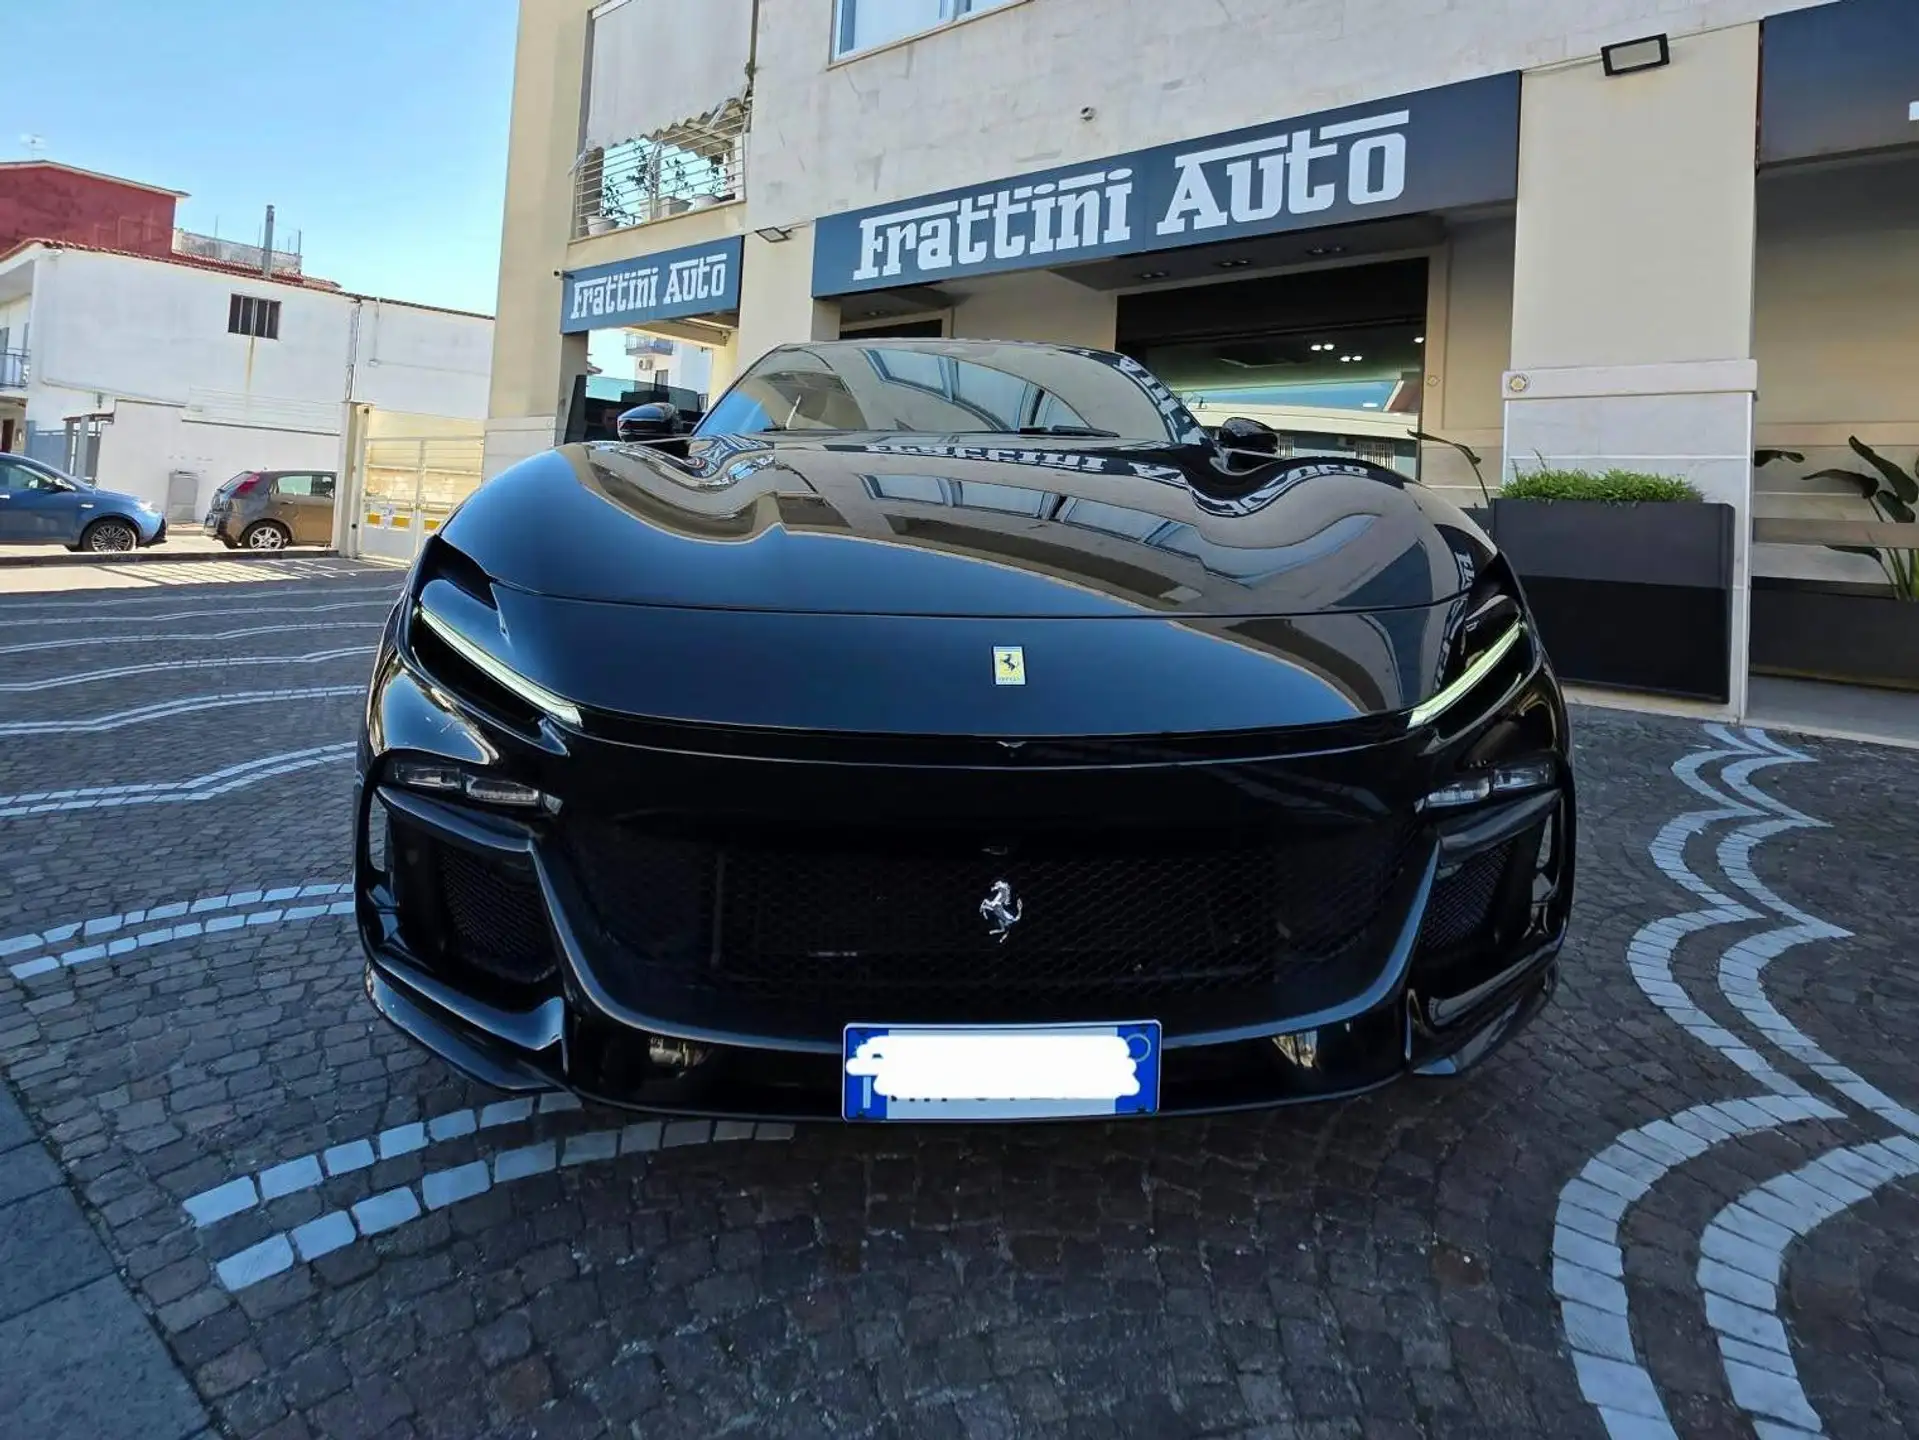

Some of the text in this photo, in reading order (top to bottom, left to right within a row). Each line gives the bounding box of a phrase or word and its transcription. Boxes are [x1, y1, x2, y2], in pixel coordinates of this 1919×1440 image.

[852, 109, 1409, 281] Frattini Auto
[570, 253, 728, 319] Frattini Auto
